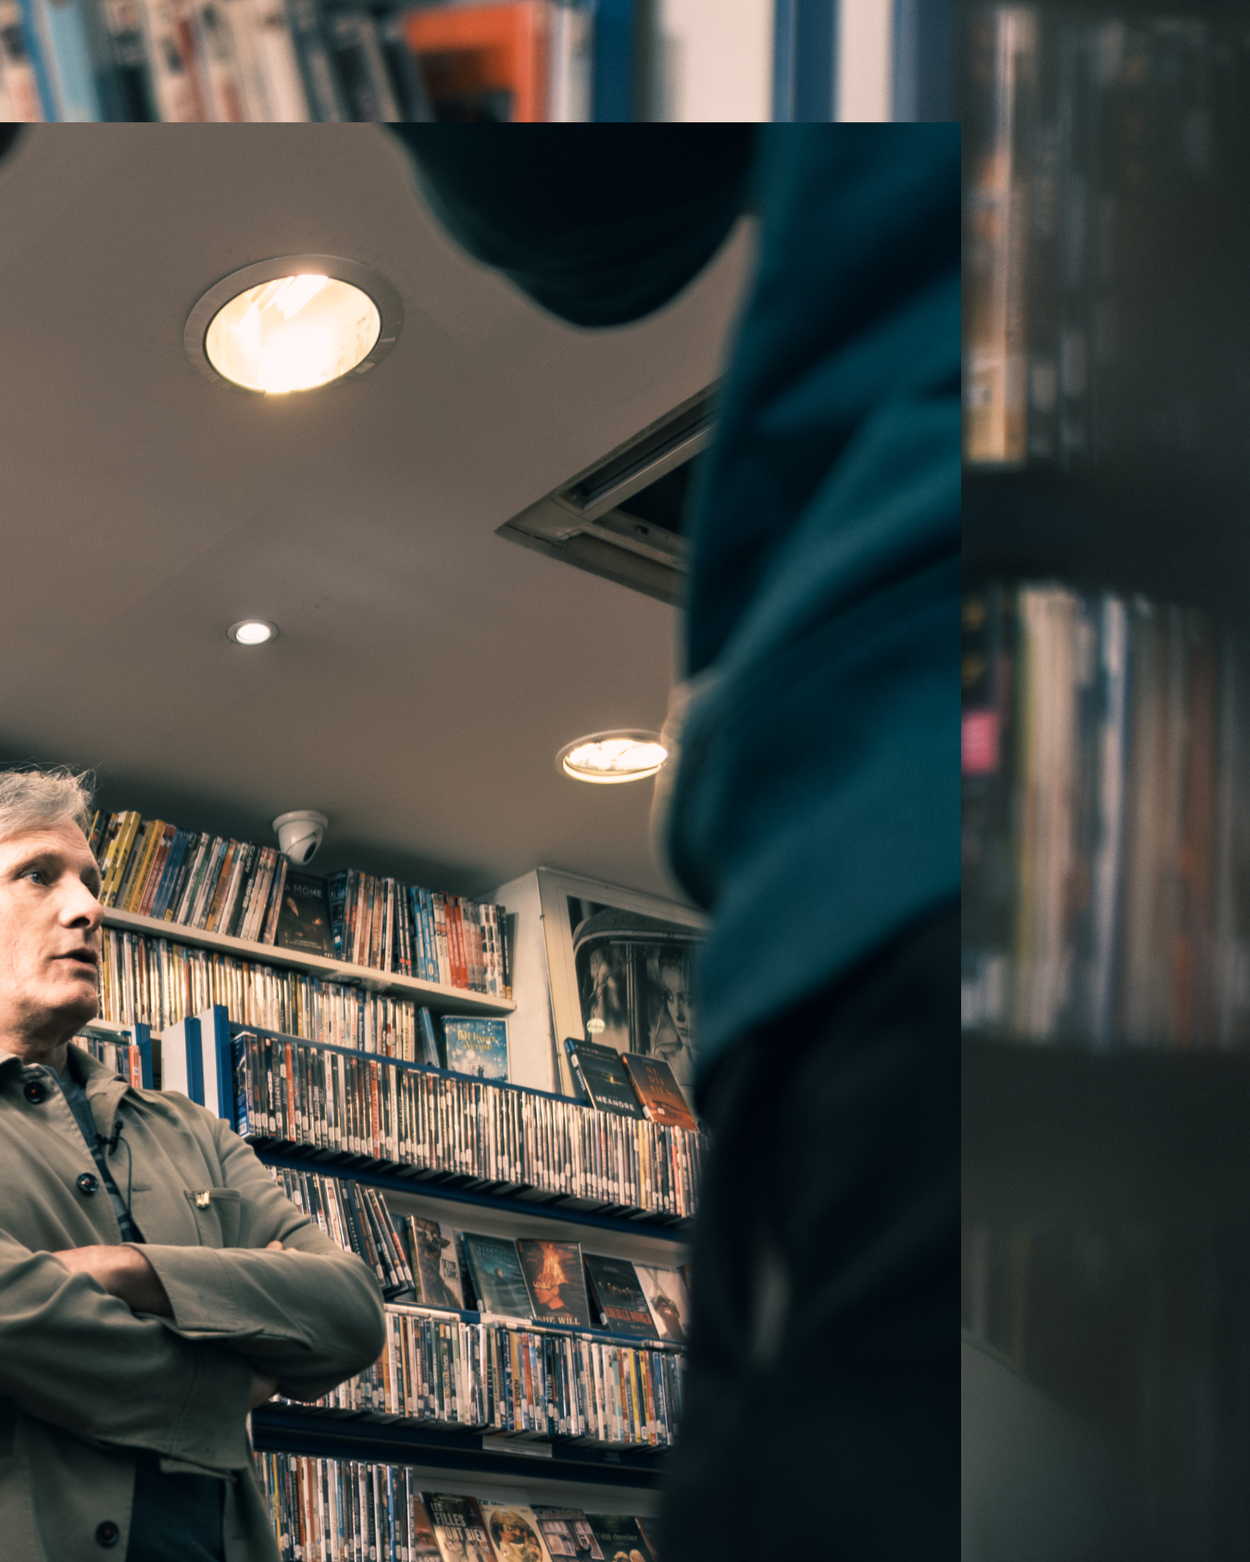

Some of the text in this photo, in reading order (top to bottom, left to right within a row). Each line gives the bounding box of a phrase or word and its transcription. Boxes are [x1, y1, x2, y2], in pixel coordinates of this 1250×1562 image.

[537, 1315, 582, 1327] SHE WILL
[430, 1502, 443, 1512] LES
[435, 1512, 466, 1528] FILLES
[437, 1525, 486, 1543] VONT BIEN
[597, 1531, 638, 1543] l'été dernier
